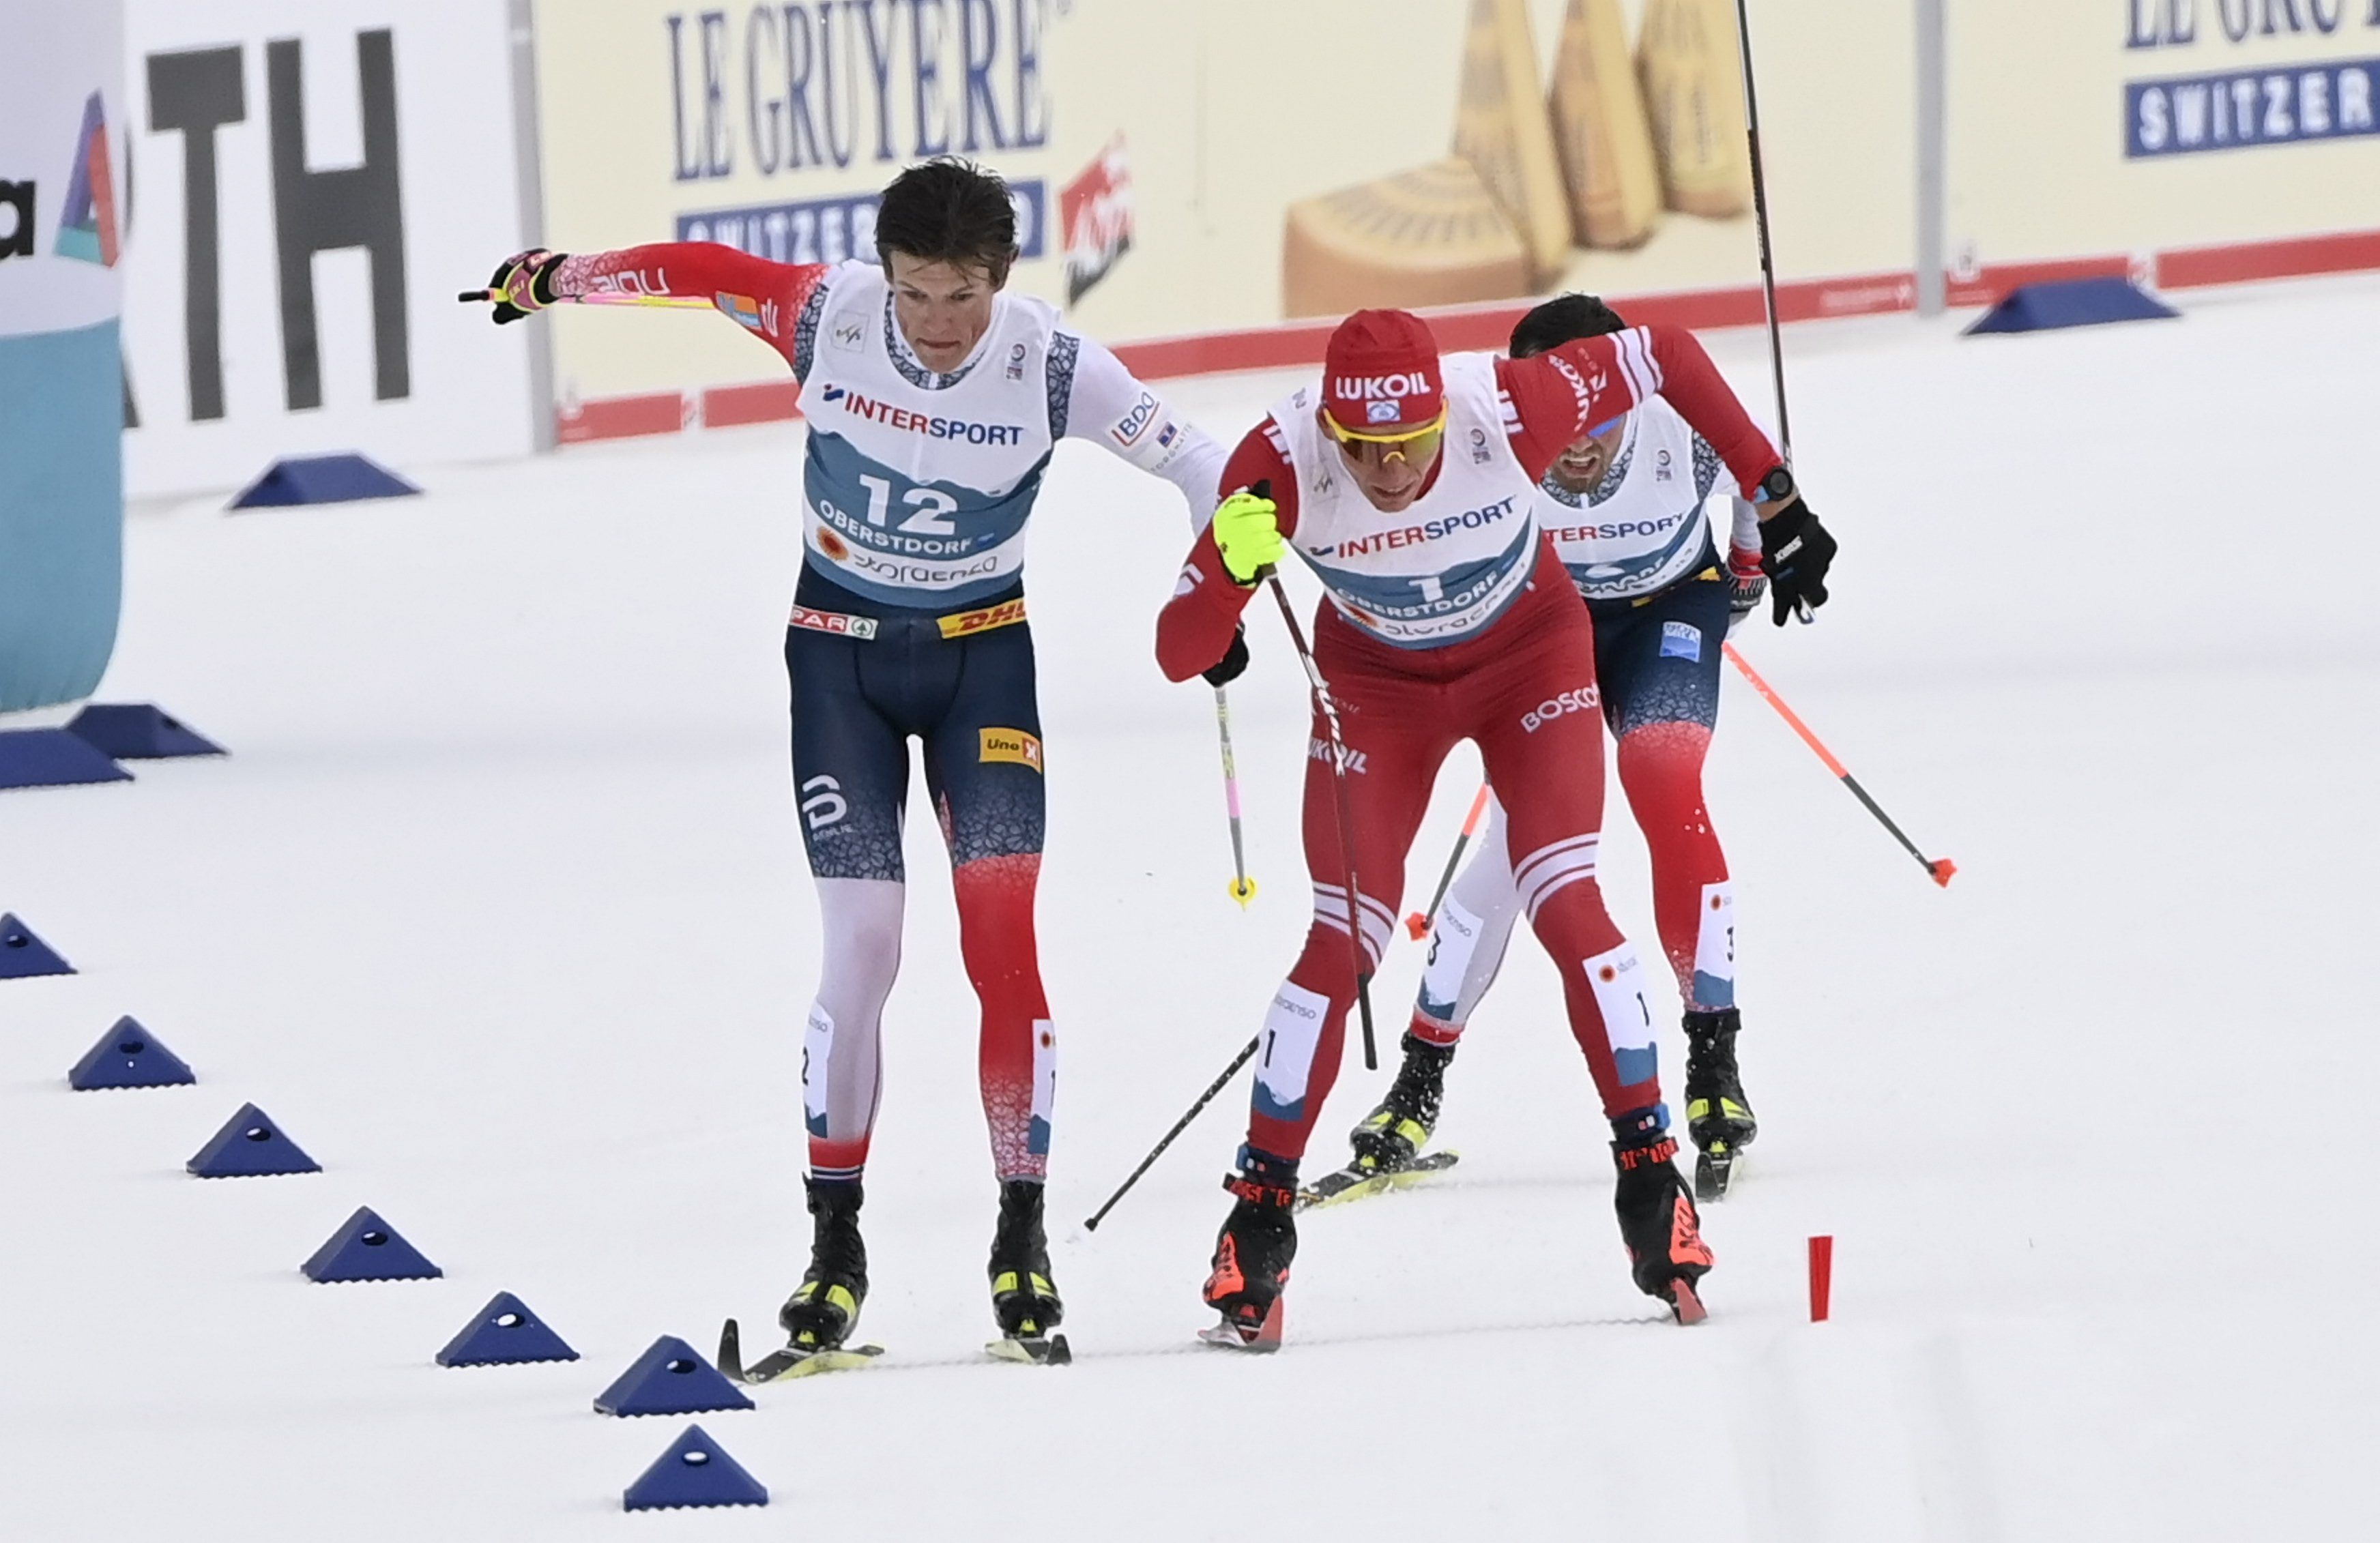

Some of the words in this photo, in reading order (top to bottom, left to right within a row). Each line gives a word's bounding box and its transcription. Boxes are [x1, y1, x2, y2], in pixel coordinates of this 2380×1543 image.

[667, 14, 730, 181] LE
[2138, 68, 2372, 151] SWITZER
[123, 27, 412, 428] TH
[1335, 371, 1432, 400] LUKOIL
[844, 392, 1026, 446] INTERSPORT
[1118, 391, 1155, 437] BDO
[819, 499, 972, 555] OBERSTDORF
[859, 473, 959, 536] 12
[1339, 496, 1516, 558] INTERSPORT
[1408, 576, 1445, 603] 1
[959, 600, 1026, 631] DHL
[987, 738, 1020, 751] Uno
[1024, 740, 1038, 761] X
[1427, 928, 1441, 967] 3
[1636, 991, 1650, 1027] 1
[1264, 1029, 1276, 1069] 1
